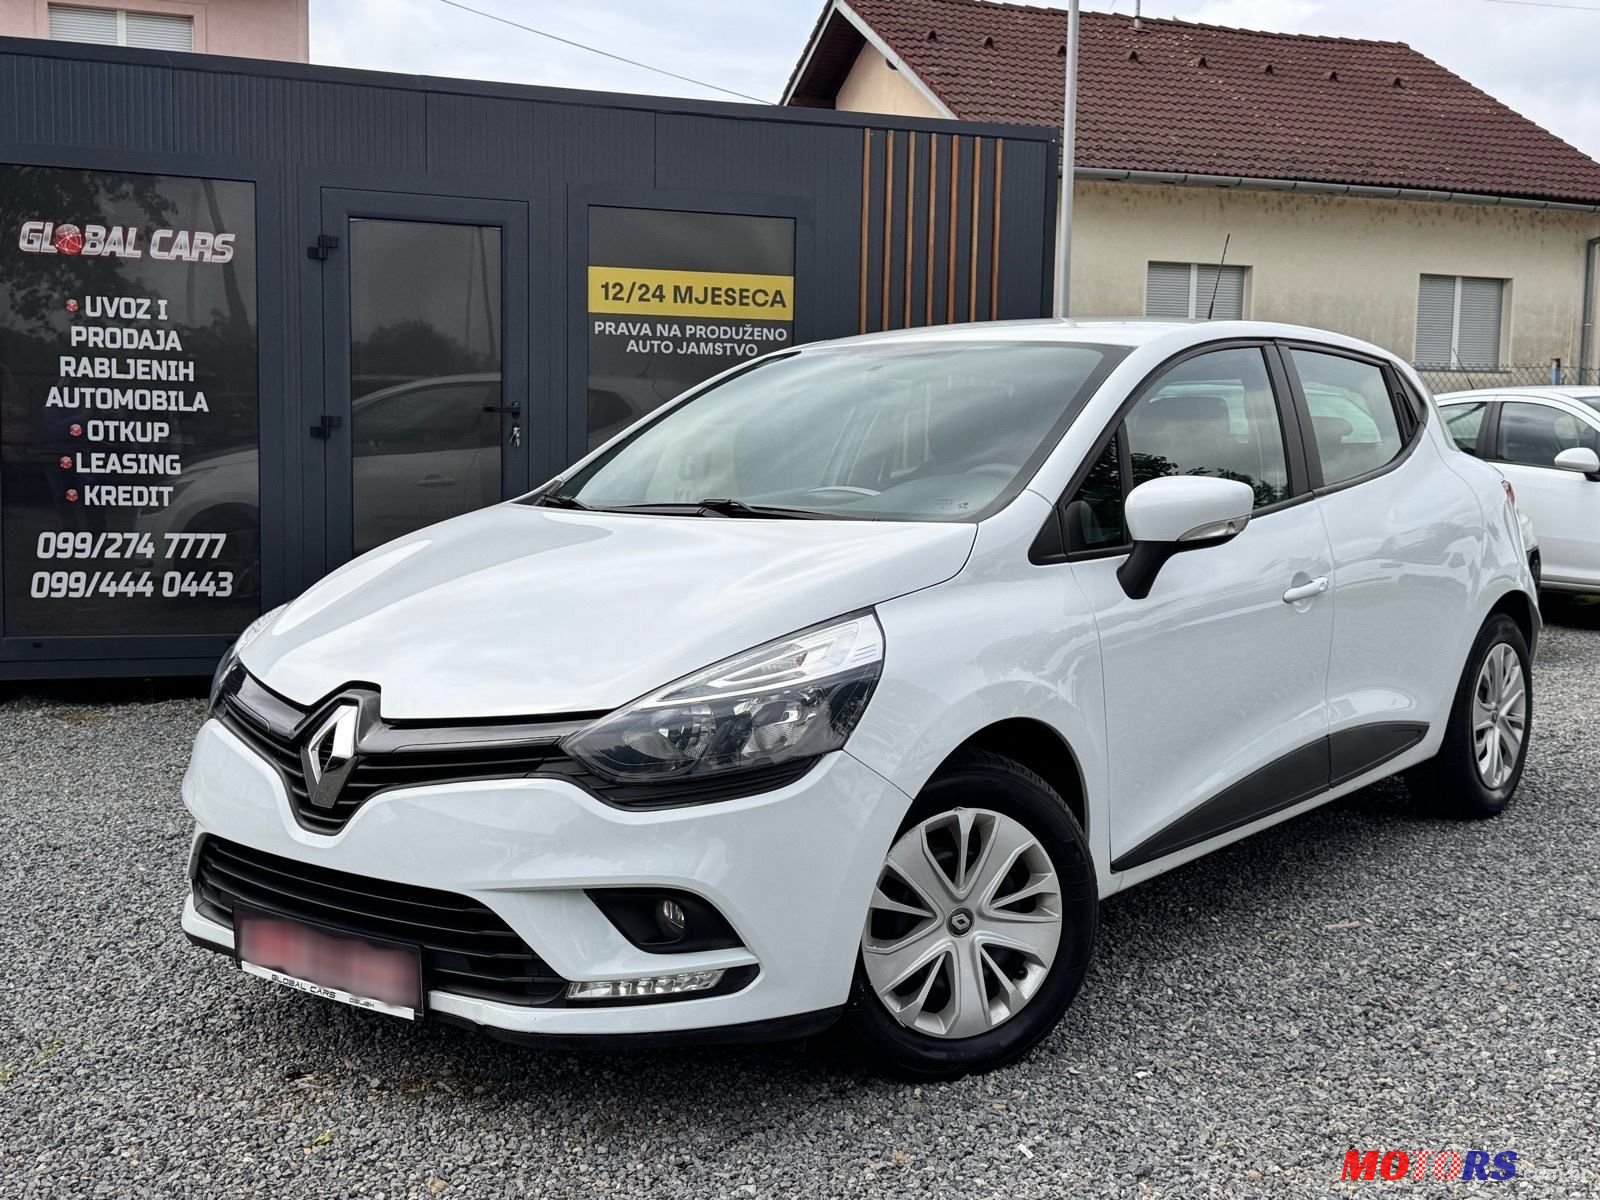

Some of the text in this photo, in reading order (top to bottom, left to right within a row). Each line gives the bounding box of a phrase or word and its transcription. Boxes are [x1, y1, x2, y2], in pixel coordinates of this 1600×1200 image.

[18, 221, 236, 263] GLOBAL CARS
[600, 281, 787, 308] 12/24 MJESECA
[85, 296, 168, 321] UVOZ I
[71, 325, 182, 351] PRODAJA
[594, 321, 788, 341] PRAVA NA PRODUŽENO
[626, 339, 758, 356] AUTO JAMSTVO
[59, 356, 195, 382] RABLJENIH
[45, 386, 209, 413] AUTOMOBILA
[87, 420, 170, 443] OTKUP
[76, 452, 182, 475] LEASING
[84, 485, 174, 507] KREDIT
[36, 531, 227, 559] 099/274 7777
[30, 571, 234, 599] 099/444 0443
[271, 974, 336, 999] GLOBAL CARS
